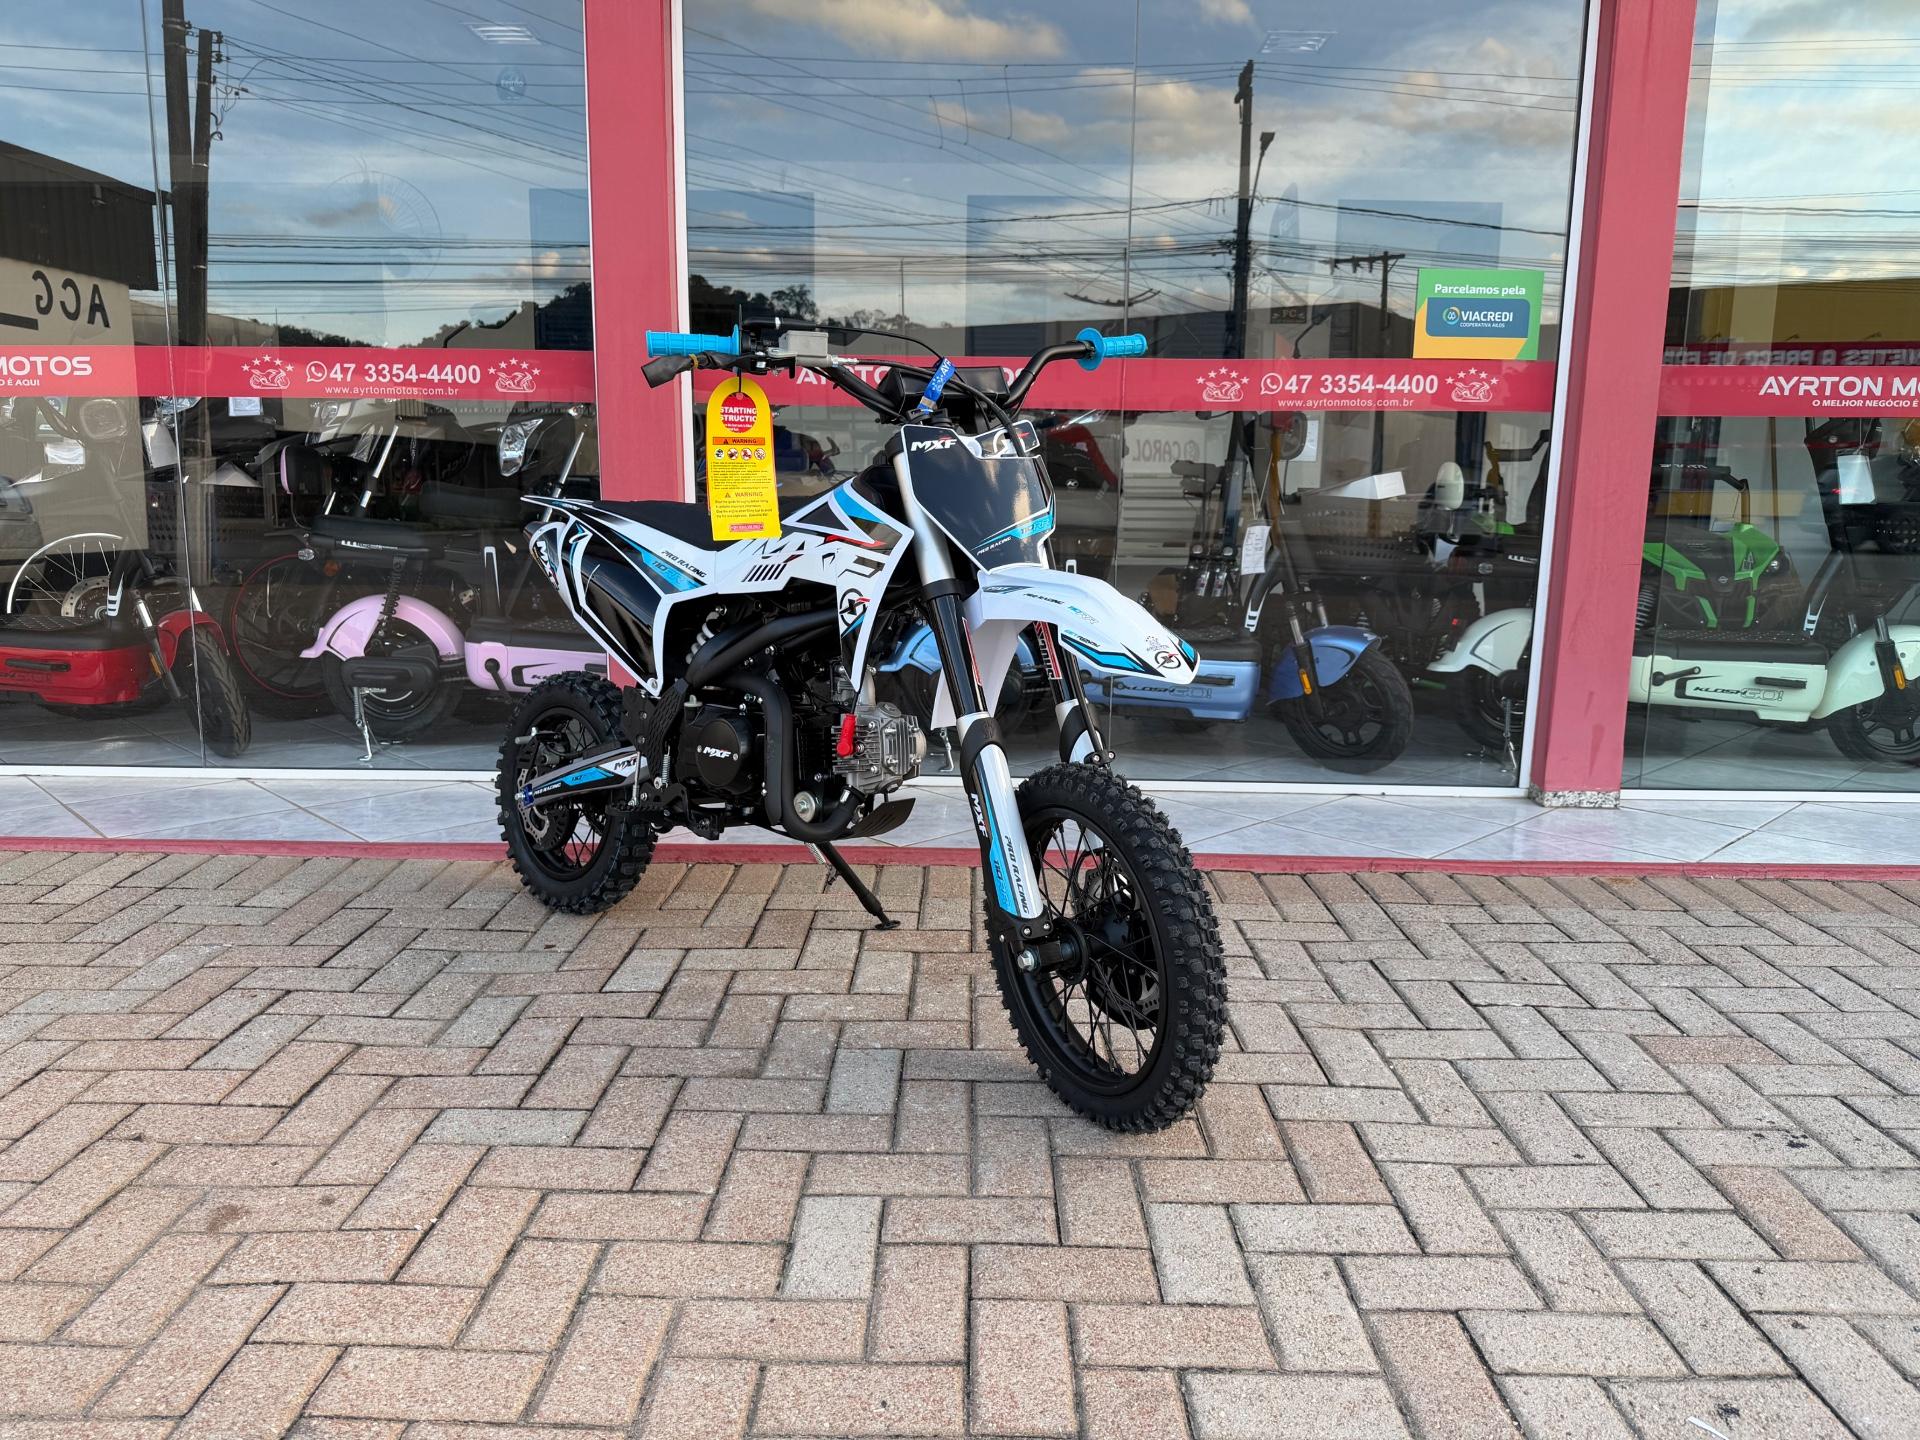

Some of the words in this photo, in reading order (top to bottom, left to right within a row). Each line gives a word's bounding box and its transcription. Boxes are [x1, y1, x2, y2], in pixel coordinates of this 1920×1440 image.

[1435, 284, 1499, 295] Parcelamos
[1501, 286, 1526, 297] pela
[1461, 311, 1514, 322] VIACREDI
[329, 363, 356, 382] 47
[364, 363, 481, 384] 3354-4400
[325, 385, 459, 396] www.ayrtonmotos.com.br
[1284, 374, 1312, 393] 47
[1319, 374, 1439, 394] 3354-4400
[1759, 376, 1883, 396] AYRTON
[1891, 377, 1920, 397] M
[1278, 398, 1413, 408] www.ayrtonmotos.com.br
[1812, 399, 1822, 407] O
[1823, 399, 1863, 407] MELHOR
[1865, 398, 1910, 407] NEGÓCIO
[910, 436, 957, 453] MXF
[677, 559, 707, 578] RACING
[970, 793, 988, 838] MXF
[1004, 835, 1016, 863] PRO
[1011, 864, 1030, 914] RACING
